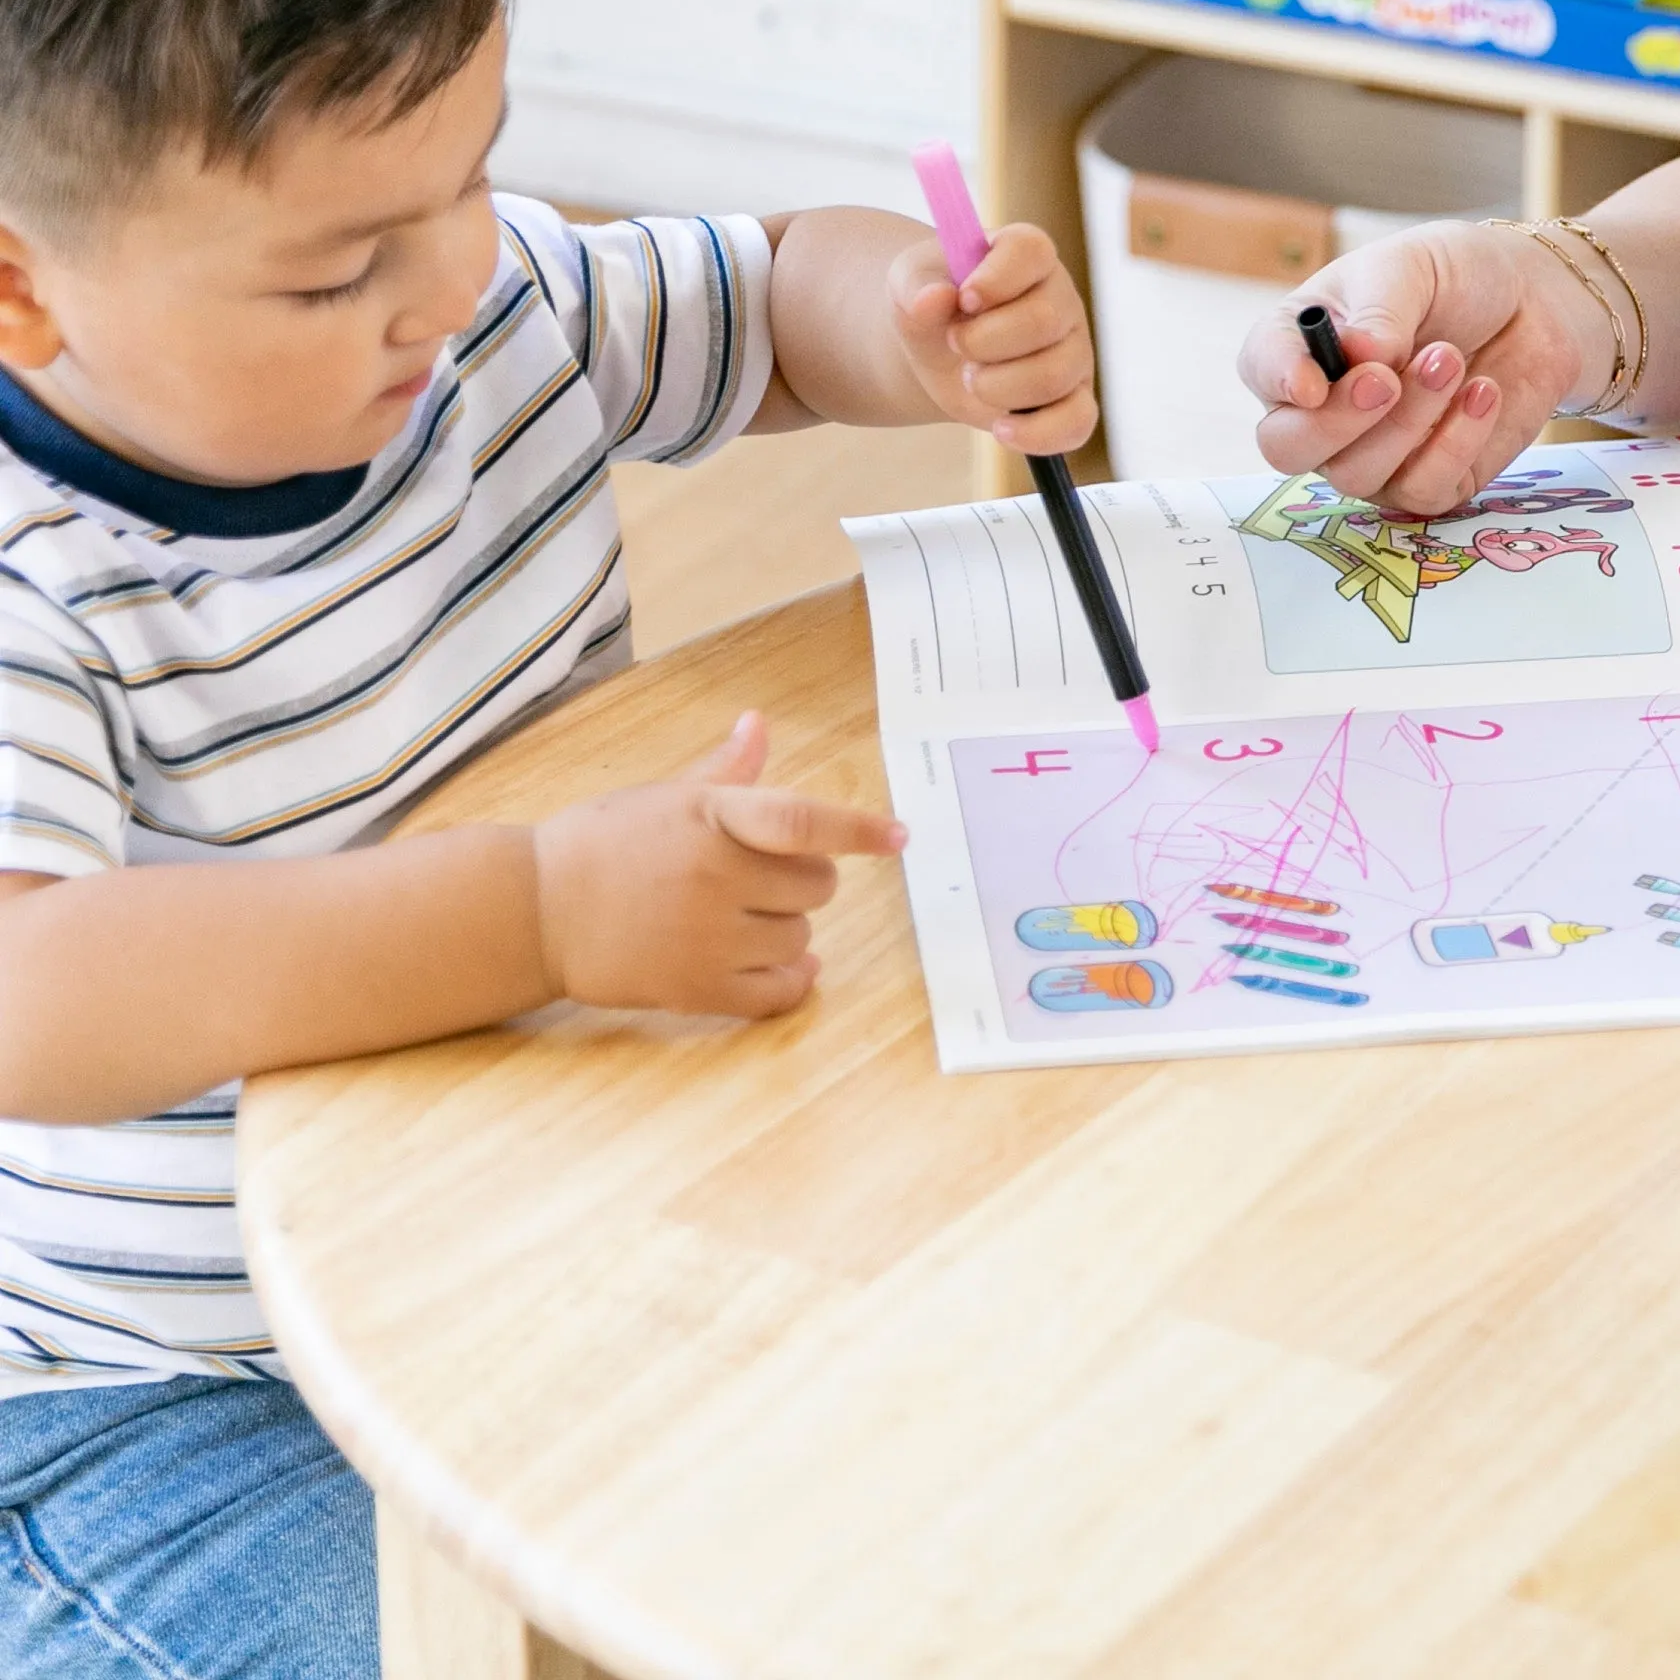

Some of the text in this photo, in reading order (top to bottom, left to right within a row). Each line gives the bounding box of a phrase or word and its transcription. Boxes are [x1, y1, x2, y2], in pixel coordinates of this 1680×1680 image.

[1178, 537, 1211, 545] 3
[1185, 556, 1219, 566] 4
[1191, 583, 1226, 596] 5
[1422, 720, 1503, 743] 2
[1203, 737, 1283, 761] 3
[991, 750, 1071, 776] 4
